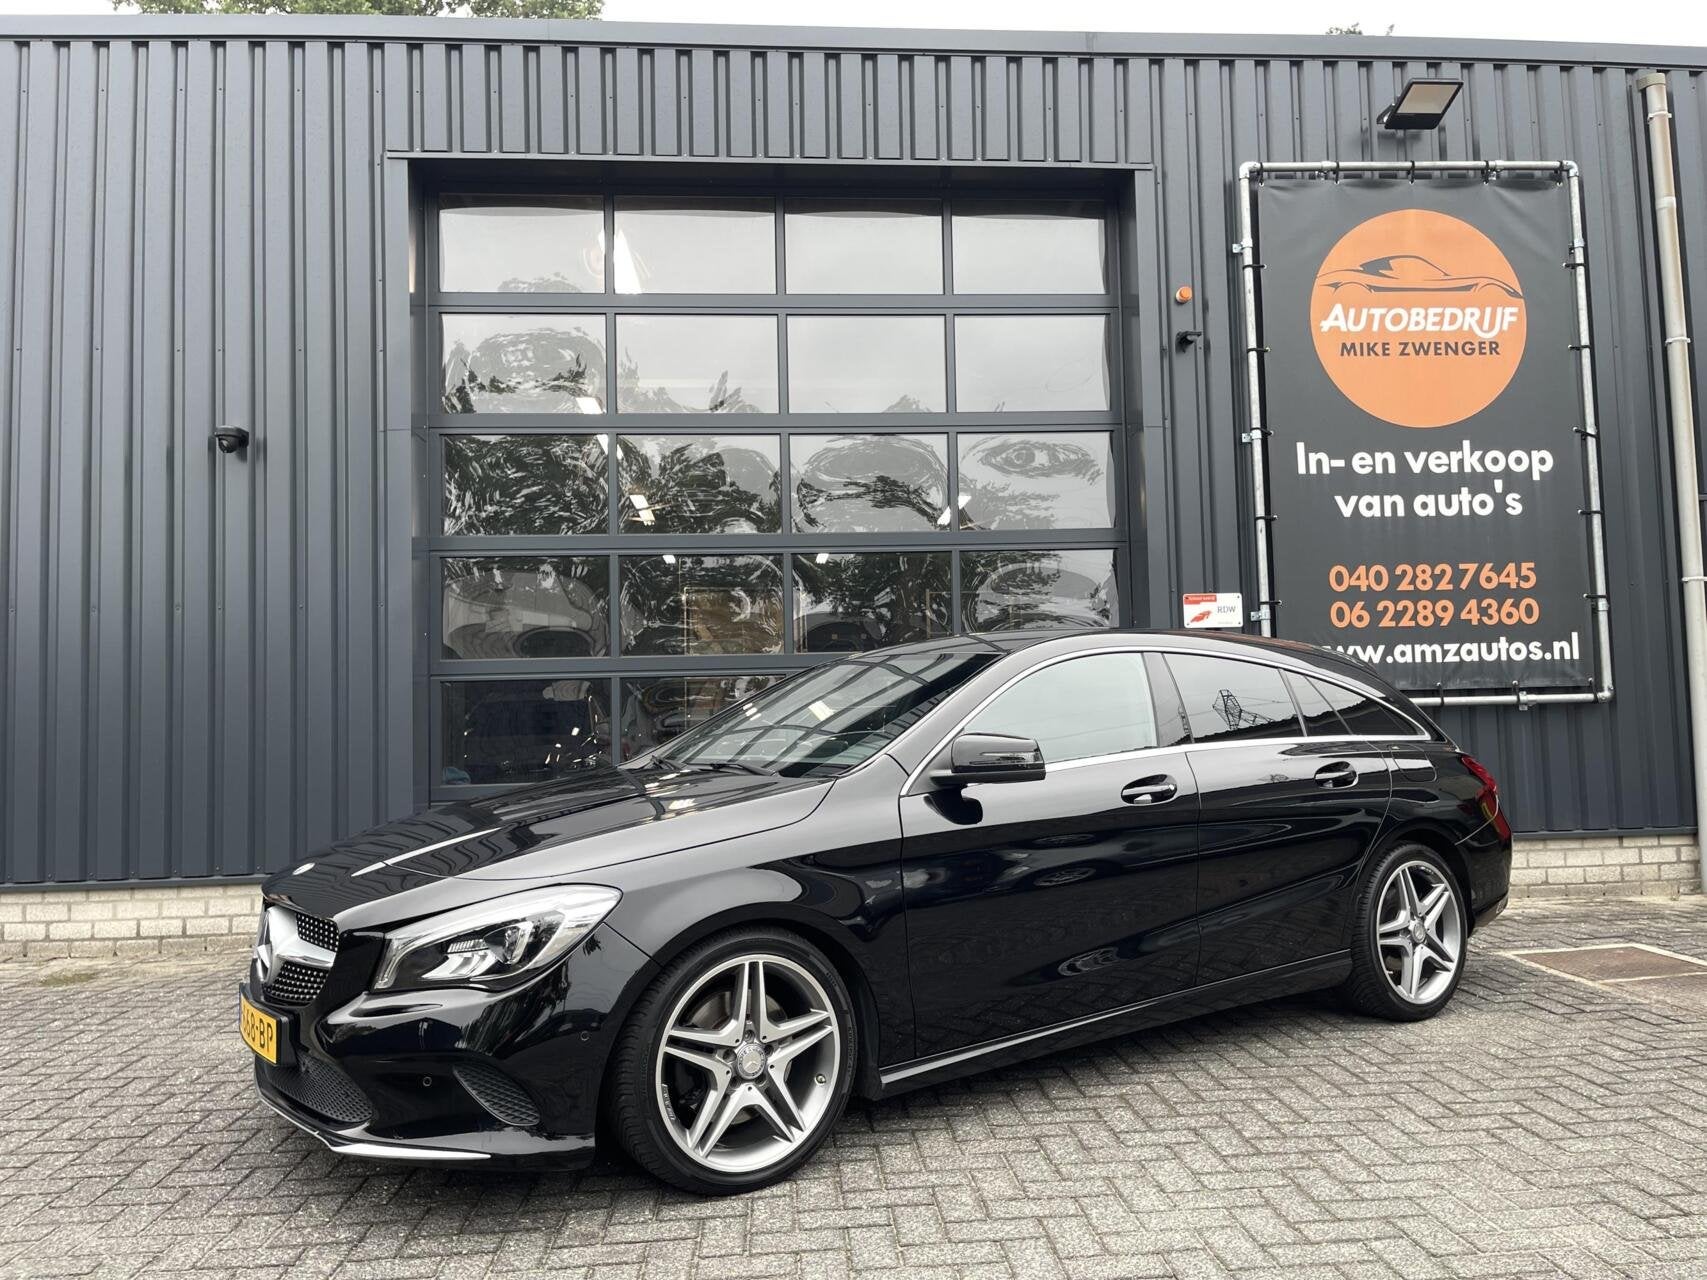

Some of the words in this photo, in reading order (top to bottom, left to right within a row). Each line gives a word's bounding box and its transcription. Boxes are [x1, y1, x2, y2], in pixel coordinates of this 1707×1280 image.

[1319, 303, 1519, 339] AUTOBEDRIJF
[1340, 341, 1391, 357] MIKE
[1398, 340, 1501, 356] ZWENGER
[1351, 451, 1396, 475] en
[1403, 439, 1554, 481] verkoop
[1334, 494, 1405, 518] van
[1413, 479, 1523, 517] auto's
[1329, 564, 1389, 592] 040
[1395, 563, 1453, 591] 282
[1460, 562, 1537, 590] 7645
[1217, 605, 1237, 614] RDW
[1330, 601, 1370, 629] 06
[1377, 599, 1454, 627] 2289
[1460, 597, 1540, 625] 4360
[1321, 631, 1580, 664] w.amzautos.nl
